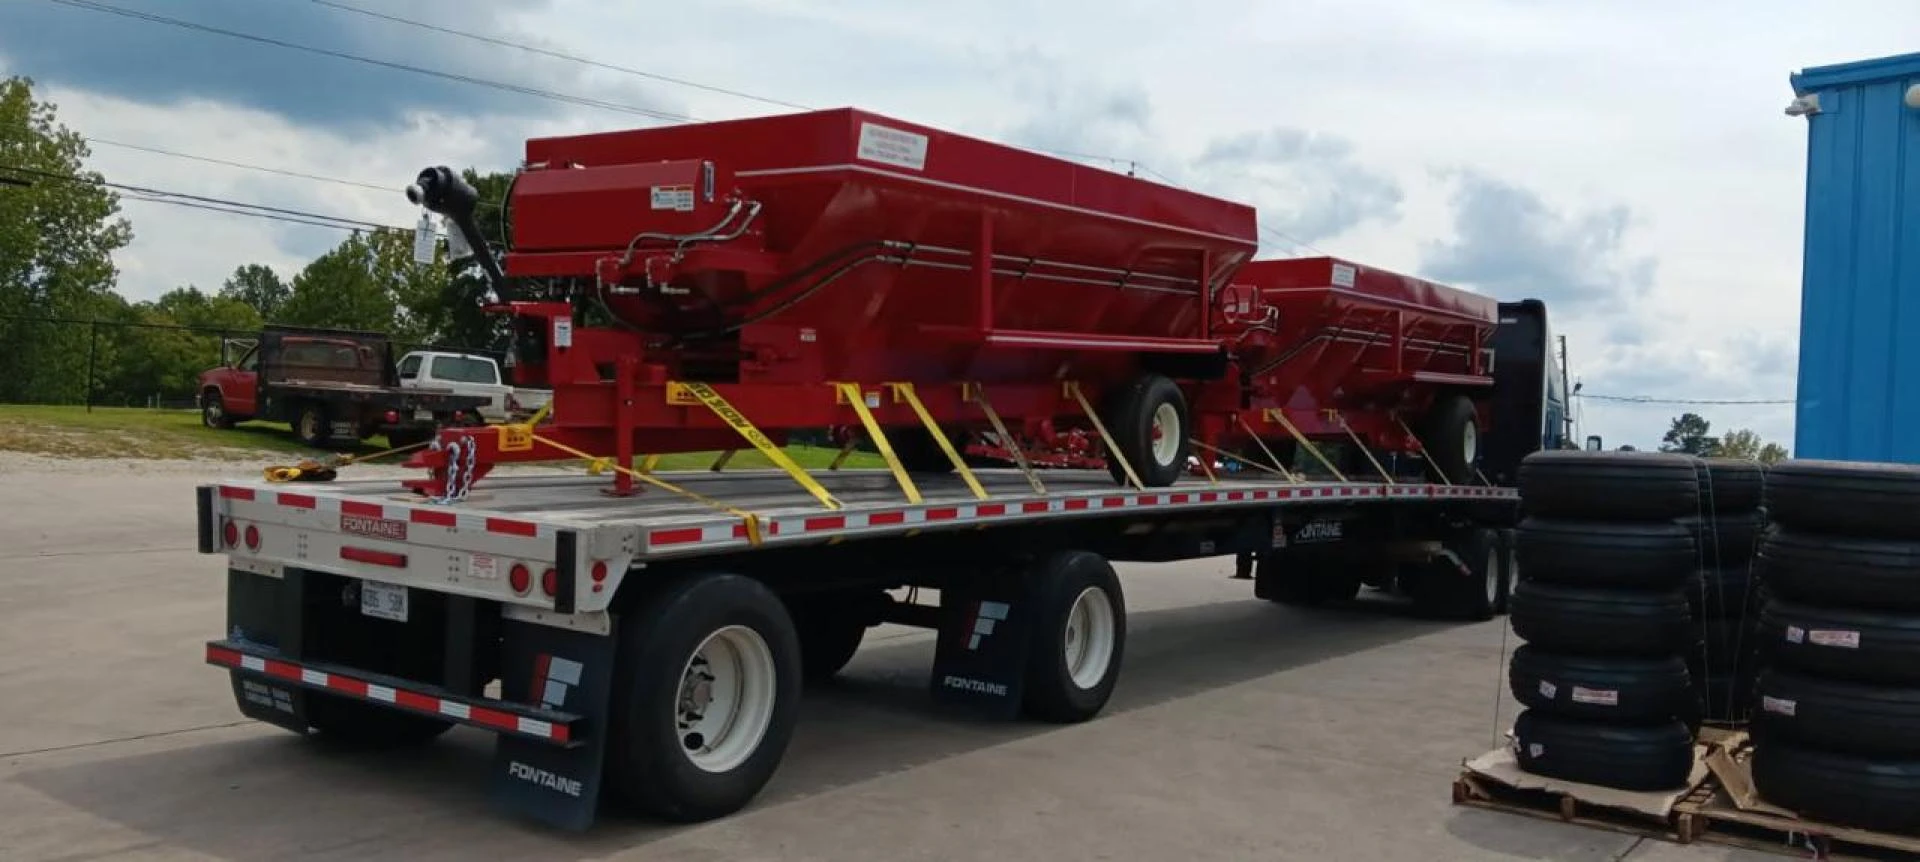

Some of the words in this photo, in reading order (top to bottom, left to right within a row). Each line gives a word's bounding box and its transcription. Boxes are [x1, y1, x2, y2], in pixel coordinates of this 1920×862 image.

[343, 518, 402, 538] FONTAINE
[944, 675, 1008, 696] FONTAINE
[509, 761, 583, 797] FONTAINE
